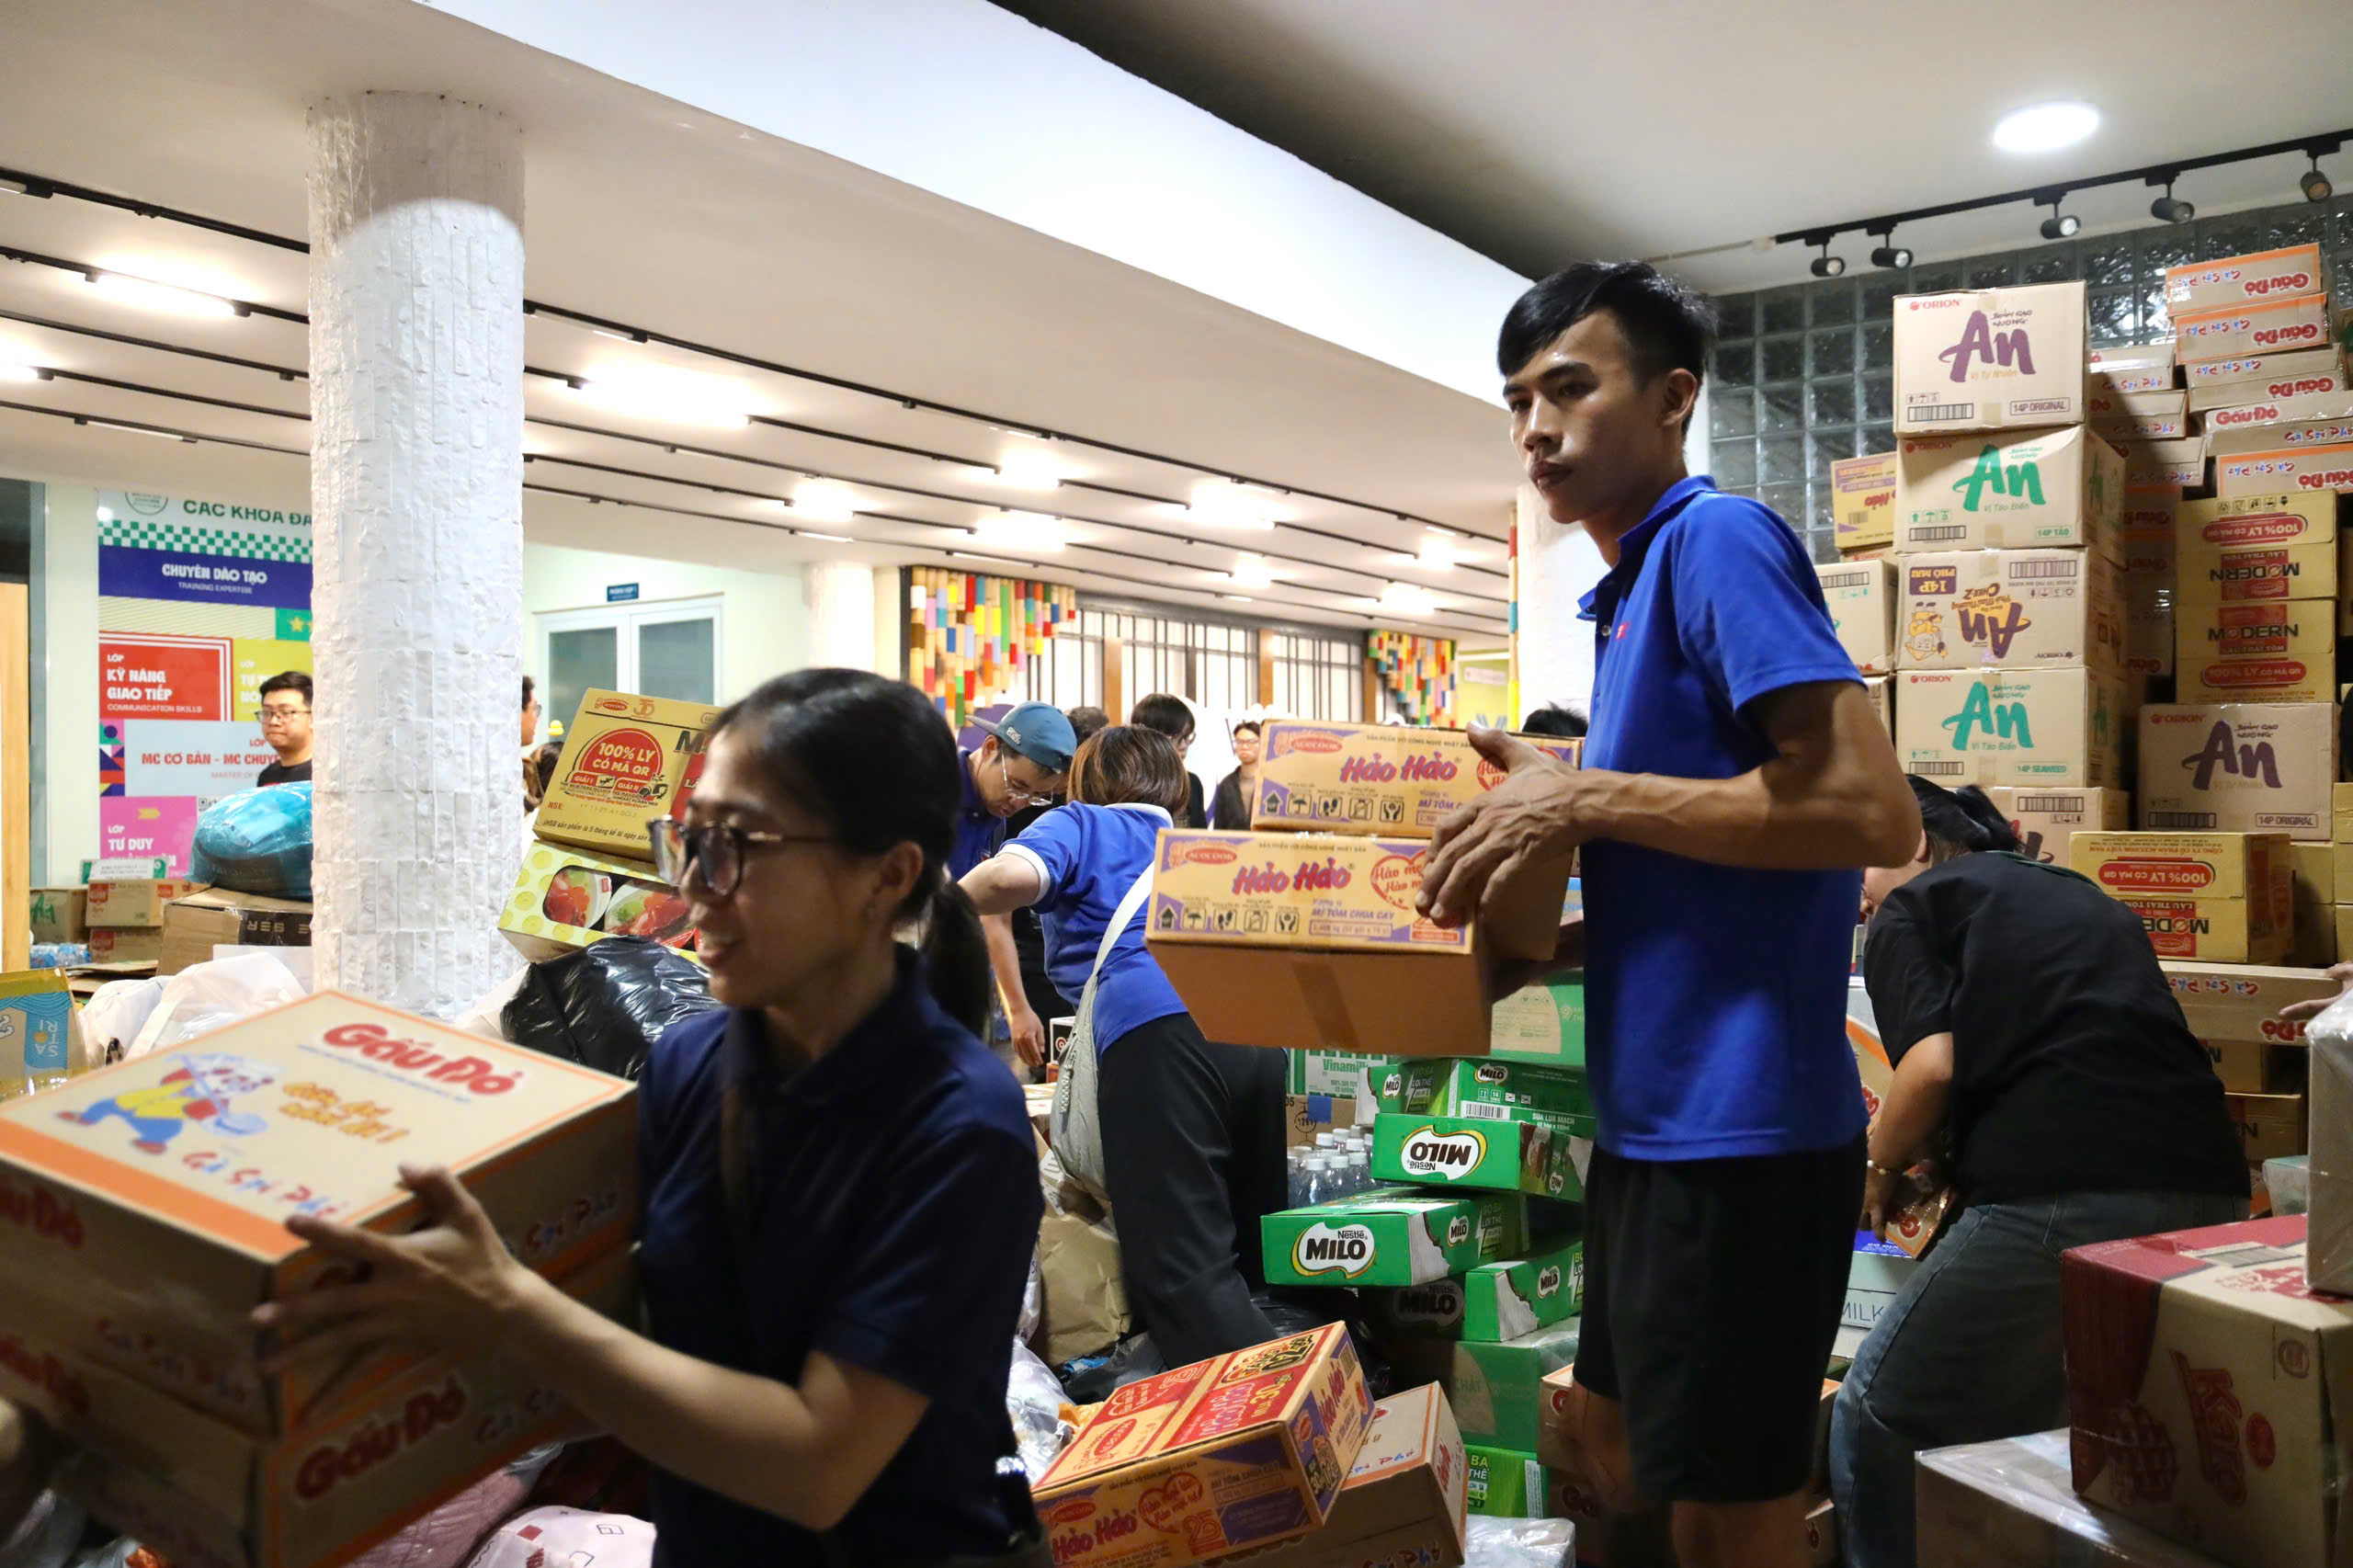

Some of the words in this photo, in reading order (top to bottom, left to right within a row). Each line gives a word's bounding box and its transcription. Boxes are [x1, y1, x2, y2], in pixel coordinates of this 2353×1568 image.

[1920, 299, 1961, 311] ORION
[1938, 310, 2037, 383] An
[2014, 403, 2029, 413] 14P
[2029, 400, 2065, 411] ORIGINAL
[1916, 440, 1952, 449] ORION
[1952, 444, 2046, 512] An
[2038, 528, 2052, 537] 14P
[2247, 527, 2262, 536] LY
[2265, 523, 2299, 535] 100%
[2210, 562, 2300, 582] MODERN
[1919, 581, 1946, 593] 14P
[1958, 602, 2031, 659] An
[2208, 623, 2299, 642] MODERN
[108, 687, 142, 699] GIAO
[108, 704, 175, 712] COMMUNICATION
[1941, 681, 2034, 751] An
[142, 754, 161, 765] MC
[224, 754, 243, 765] MC
[599, 743, 634, 759] 100%
[637, 749, 655, 763] LY
[2181, 721, 2282, 790] An
[593, 758, 608, 768] CÓ
[611, 761, 630, 772] MÃ
[632, 766, 650, 776] QR
[1339, 753, 1396, 783] Hảo
[1400, 751, 1457, 781] Hảo
[2032, 764, 2066, 773] SEAWEED
[2259, 816, 2273, 824] 14P
[2275, 816, 2313, 825] ORIGINAL
[129, 838, 153, 851] DUY
[1231, 861, 1290, 896] Hảo
[1293, 858, 1351, 892] Hảo
[2134, 871, 2147, 880] CÓ
[2149, 871, 2165, 882] LY
[2168, 872, 2206, 883] 100%
[1480, 1068, 1505, 1080] MILO
[1385, 1079, 1400, 1094] MILO
[1410, 1142, 1472, 1162] MILO
[1412, 1160, 1436, 1171] Nestlé
[1337, 1230, 1365, 1240] Nestlé
[1450, 1223, 1467, 1238] MILO
[1305, 1238, 1367, 1260] MILO
[1540, 1274, 1559, 1289] MILO
[1052, 1527, 1094, 1562] Hảo
[1095, 1509, 1138, 1544] Hảo
